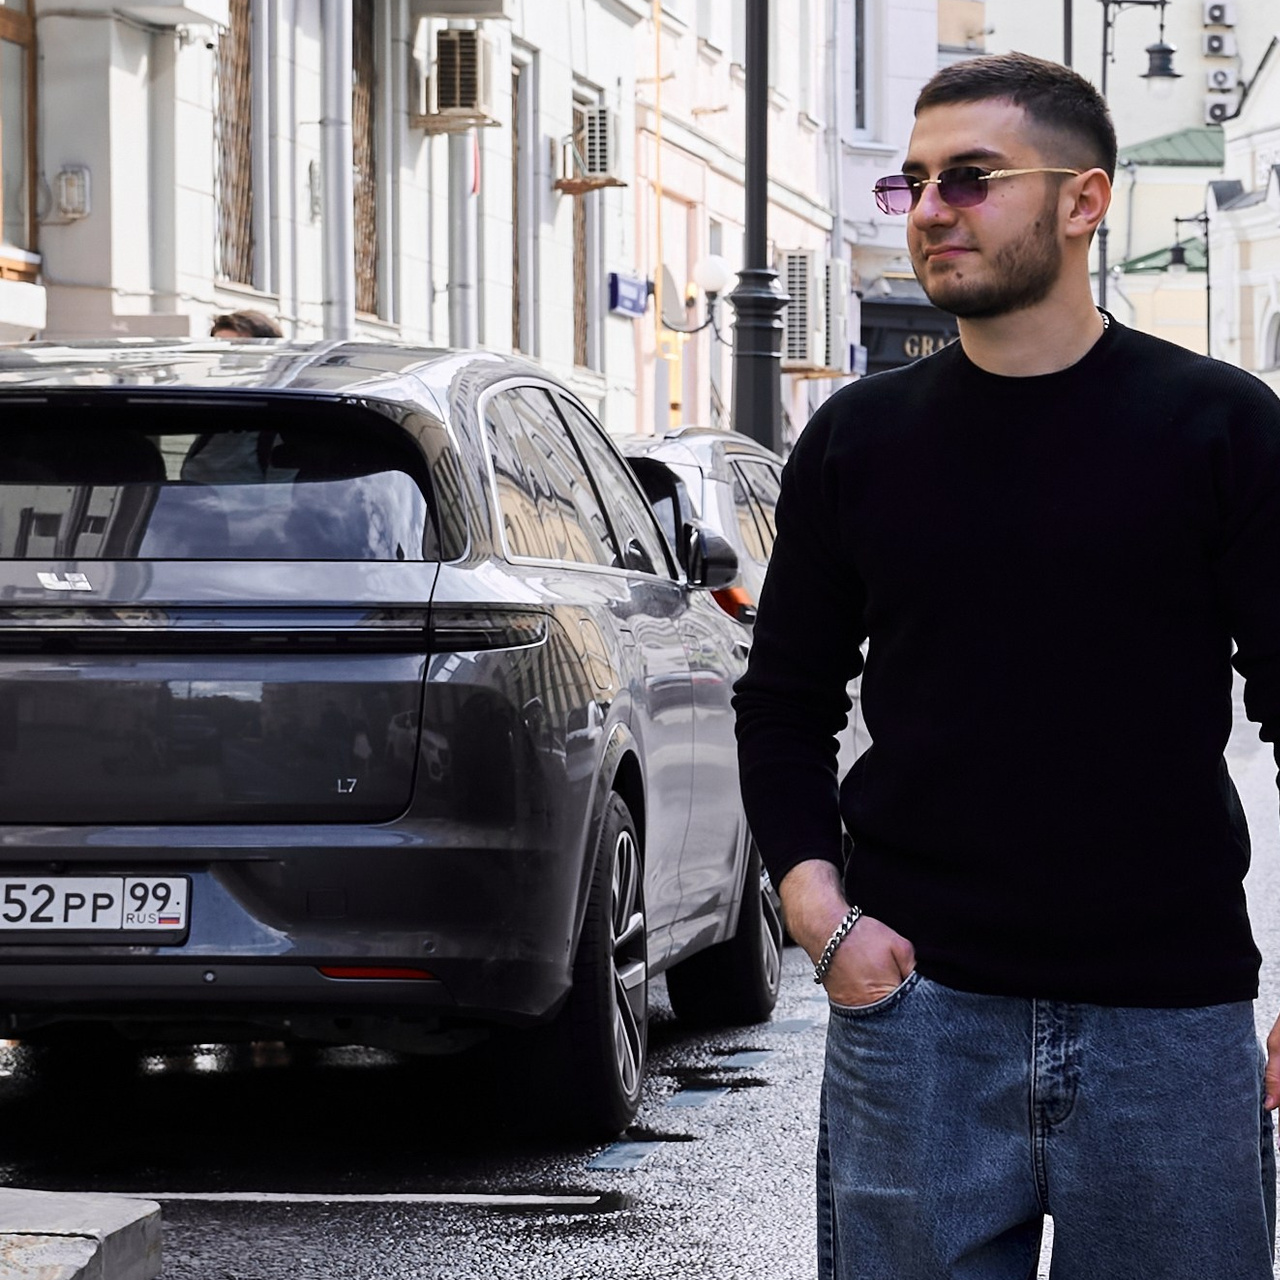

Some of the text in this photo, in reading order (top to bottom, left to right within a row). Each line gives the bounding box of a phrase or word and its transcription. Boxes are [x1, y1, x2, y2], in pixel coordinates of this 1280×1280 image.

[905, 334, 957, 357] GRA
[338, 778, 357, 793] L7
[130, 882, 171, 912] 99
[126, 913, 157, 924] RUS
